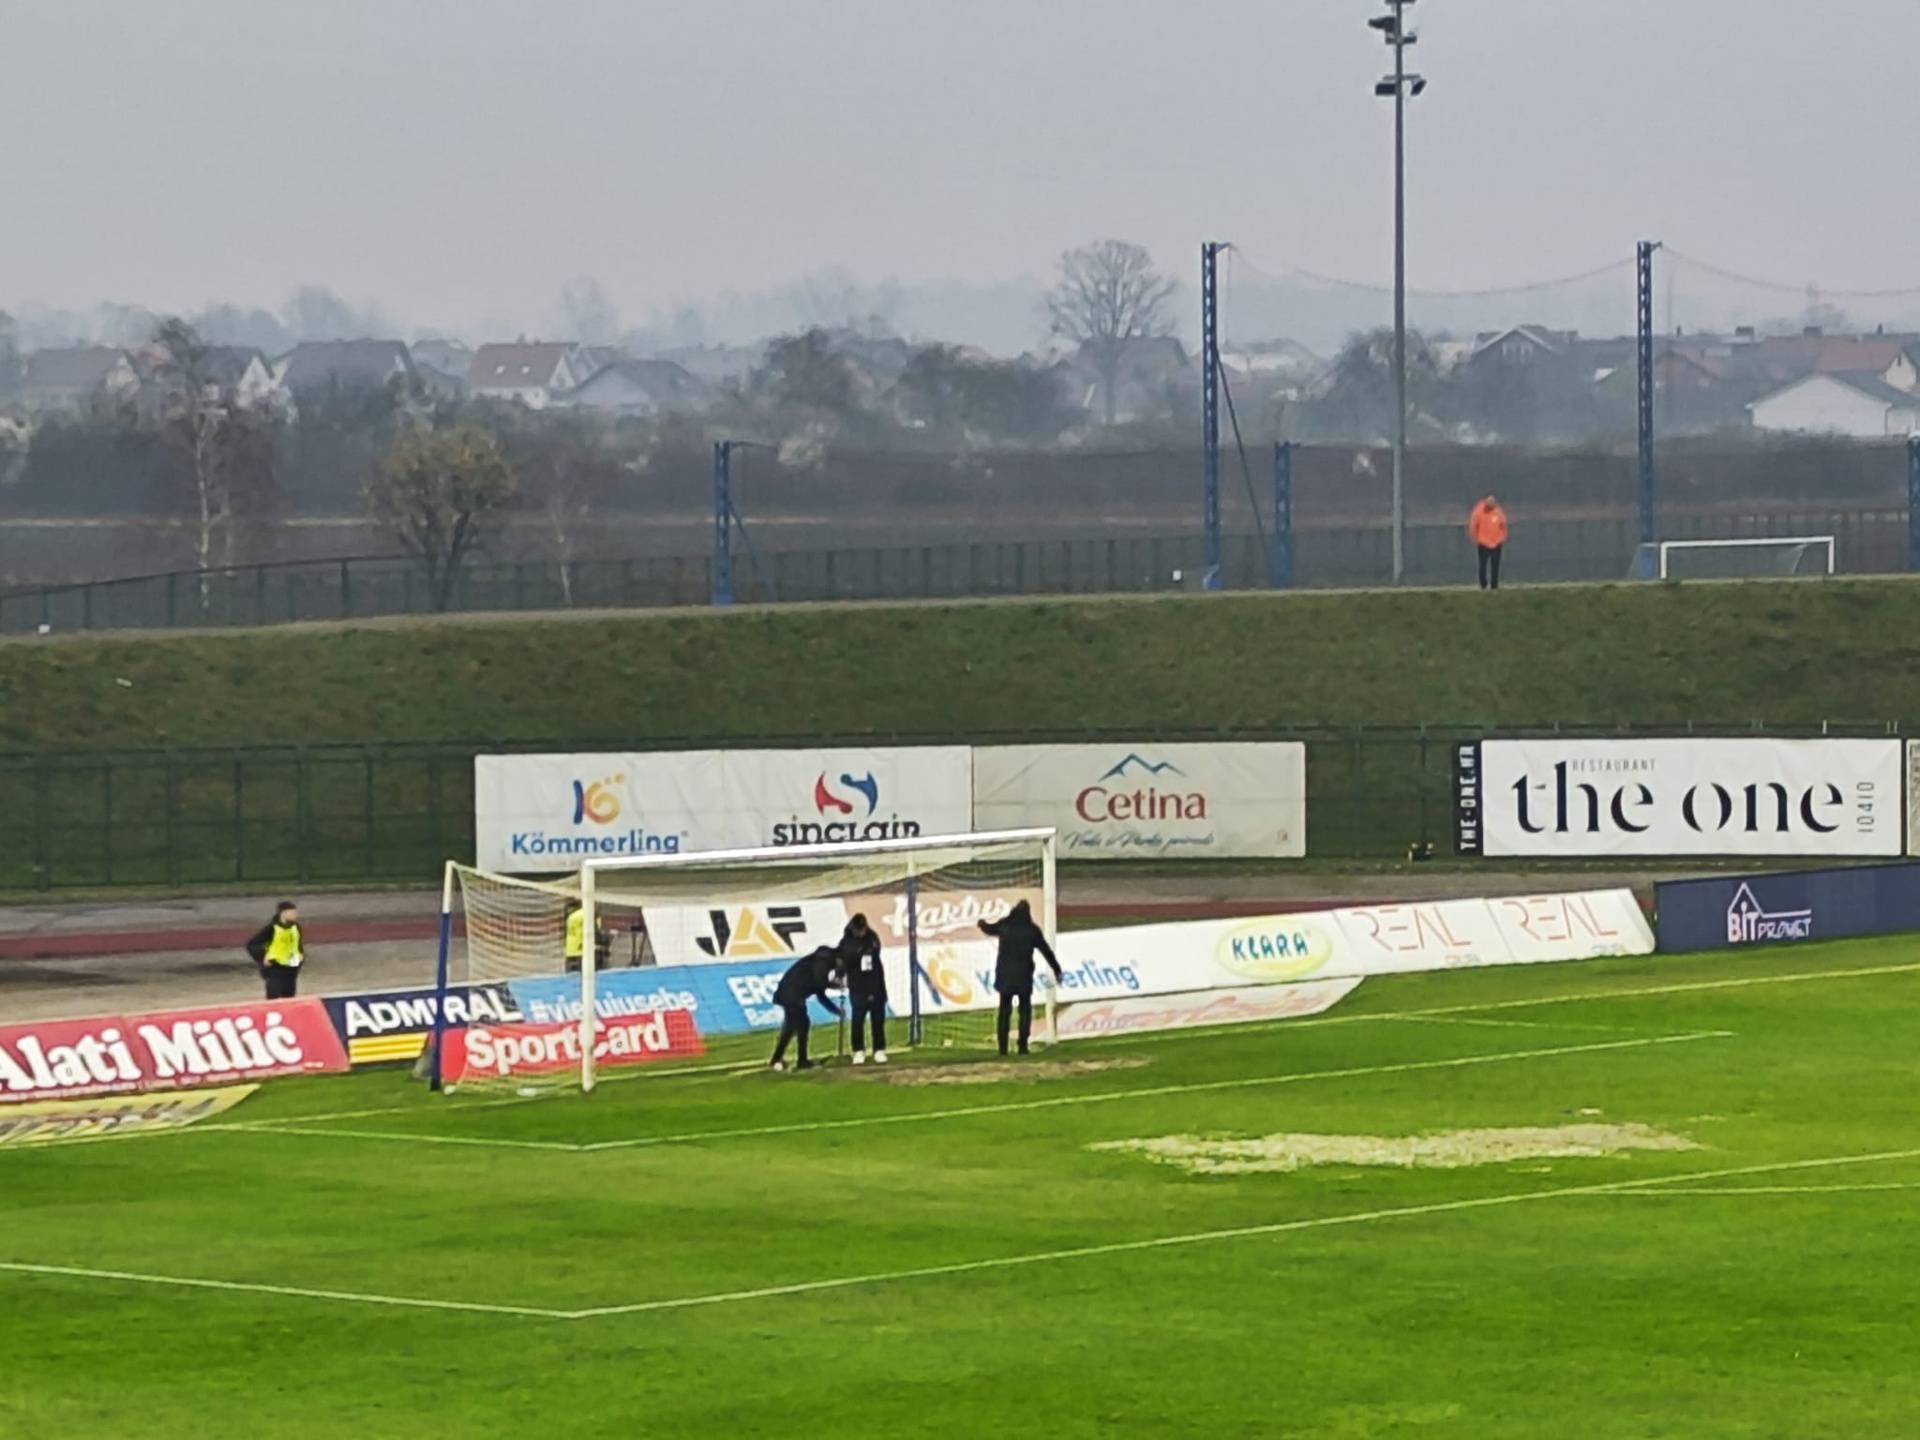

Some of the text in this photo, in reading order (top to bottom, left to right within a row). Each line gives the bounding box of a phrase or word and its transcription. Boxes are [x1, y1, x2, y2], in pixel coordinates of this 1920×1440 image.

[1572, 758, 1656, 772] RESTAURANT
[1075, 786, 1207, 823] Cetina
[1511, 761, 1844, 833] the one
[1857, 782, 1875, 832] 10410
[512, 829, 680, 854] Kömmerling
[695, 906, 807, 957] JAF
[1352, 907, 1472, 951] REAL
[1502, 898, 1619, 942] REAL
[1231, 931, 1309, 961] KLARA
[975, 959, 1139, 996] Kerling
[138, 1012, 302, 1077] Milić
